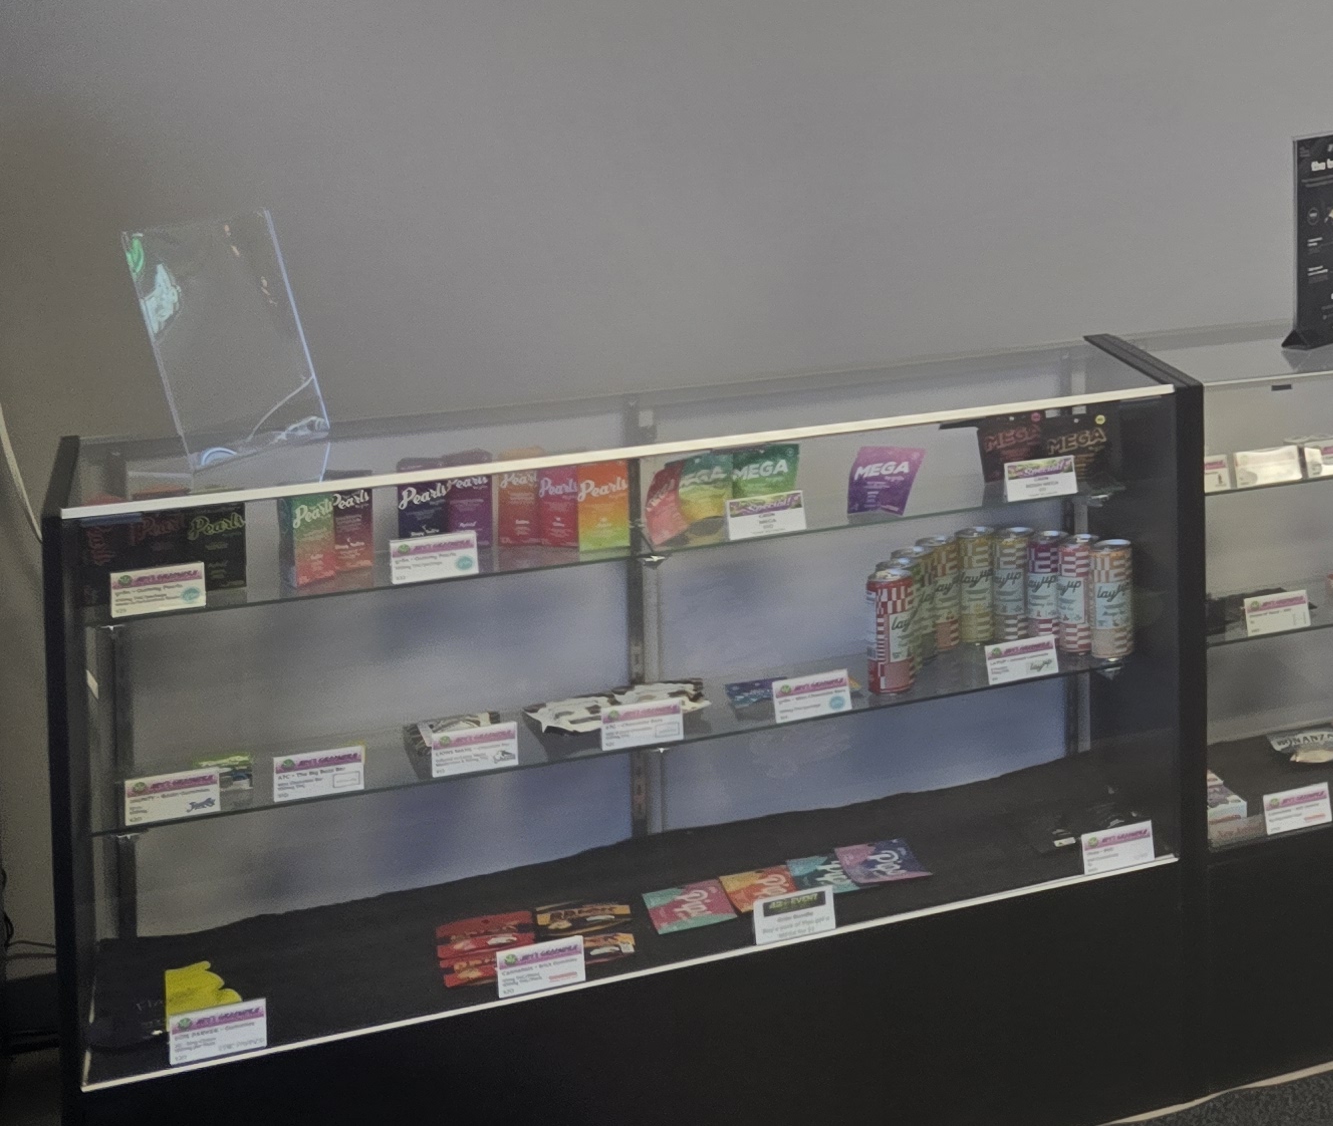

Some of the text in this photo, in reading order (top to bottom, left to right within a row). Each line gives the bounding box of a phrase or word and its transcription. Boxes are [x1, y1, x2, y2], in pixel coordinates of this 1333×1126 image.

[1047, 427, 1107, 455] MEGA
[732, 459, 789, 481] MEGA
[854, 460, 910, 481] MEGA
[398, 483, 450, 510] Pearls
[577, 476, 628, 502] Pearls
[187, 512, 246, 541] Pearls
[1096, 581, 1129, 603] layup
[1276, 733, 1333, 747] BONANZA
